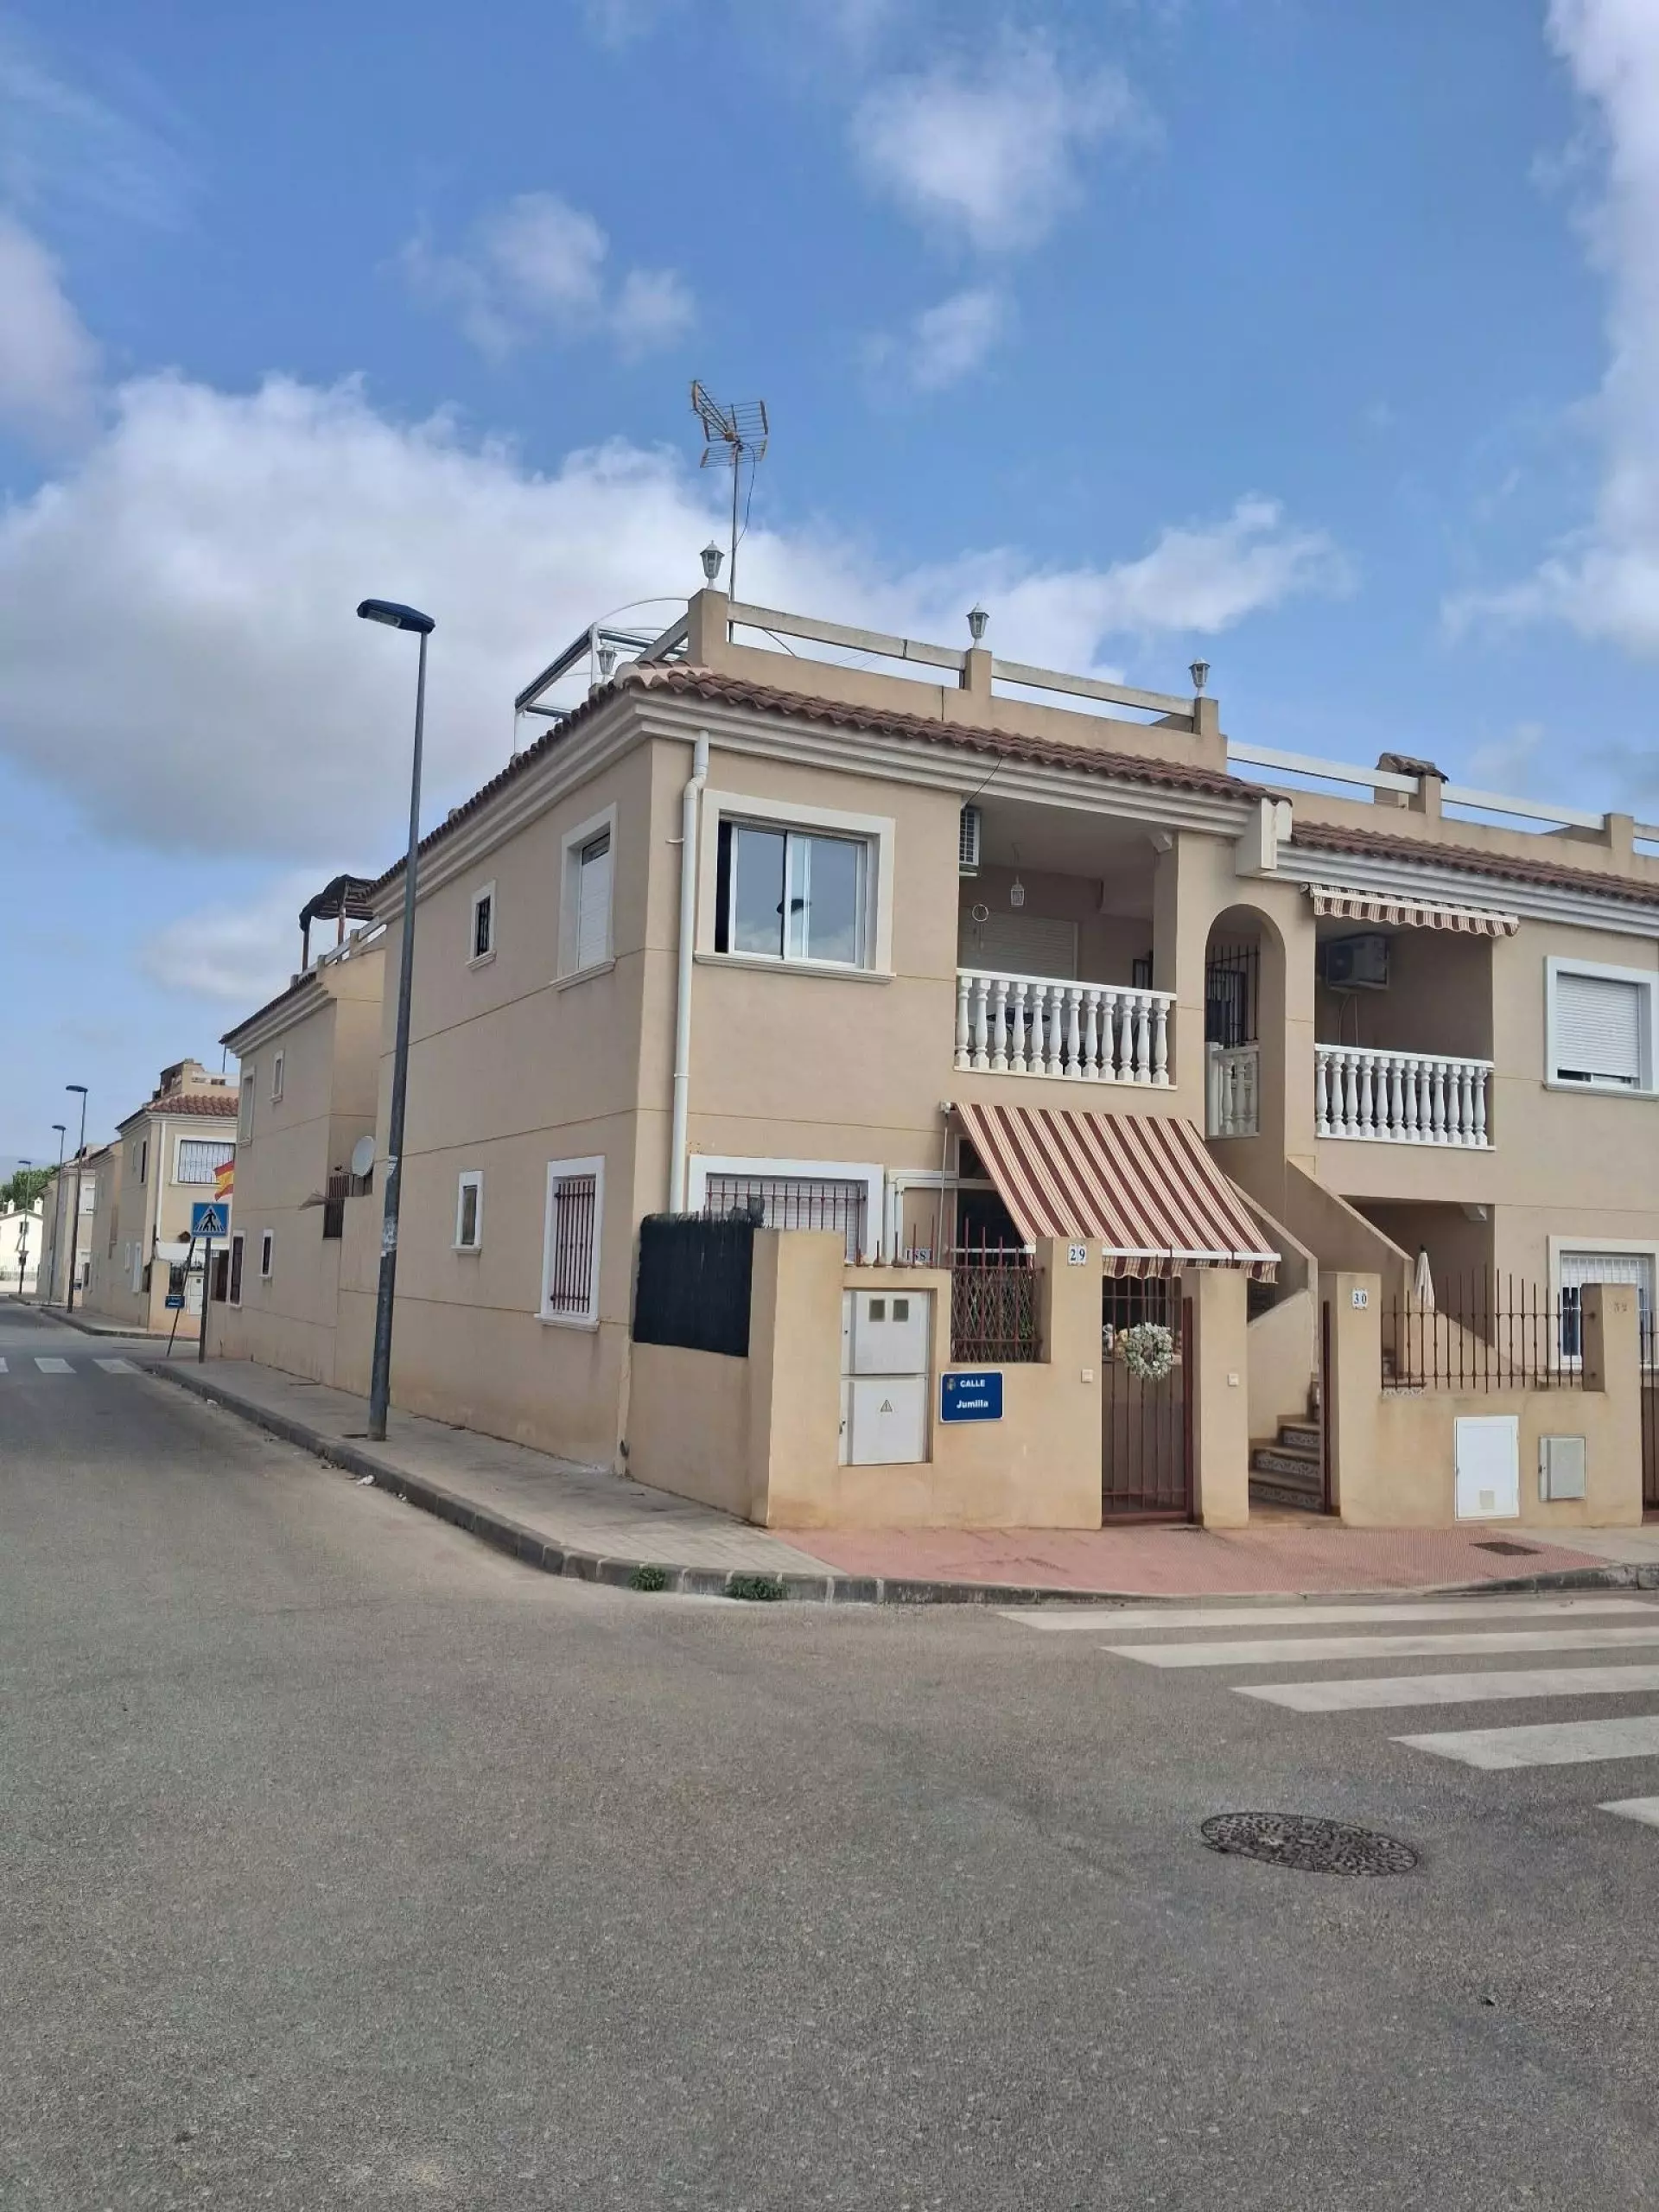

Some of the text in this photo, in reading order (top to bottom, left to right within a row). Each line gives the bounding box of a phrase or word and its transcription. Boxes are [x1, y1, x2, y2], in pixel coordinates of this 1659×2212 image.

[1071, 1248, 1085, 1261] 29
[1354, 1293, 1367, 1305] 30
[959, 1379, 986, 1388] CALLE
[956, 1400, 989, 1409] Jumilla
